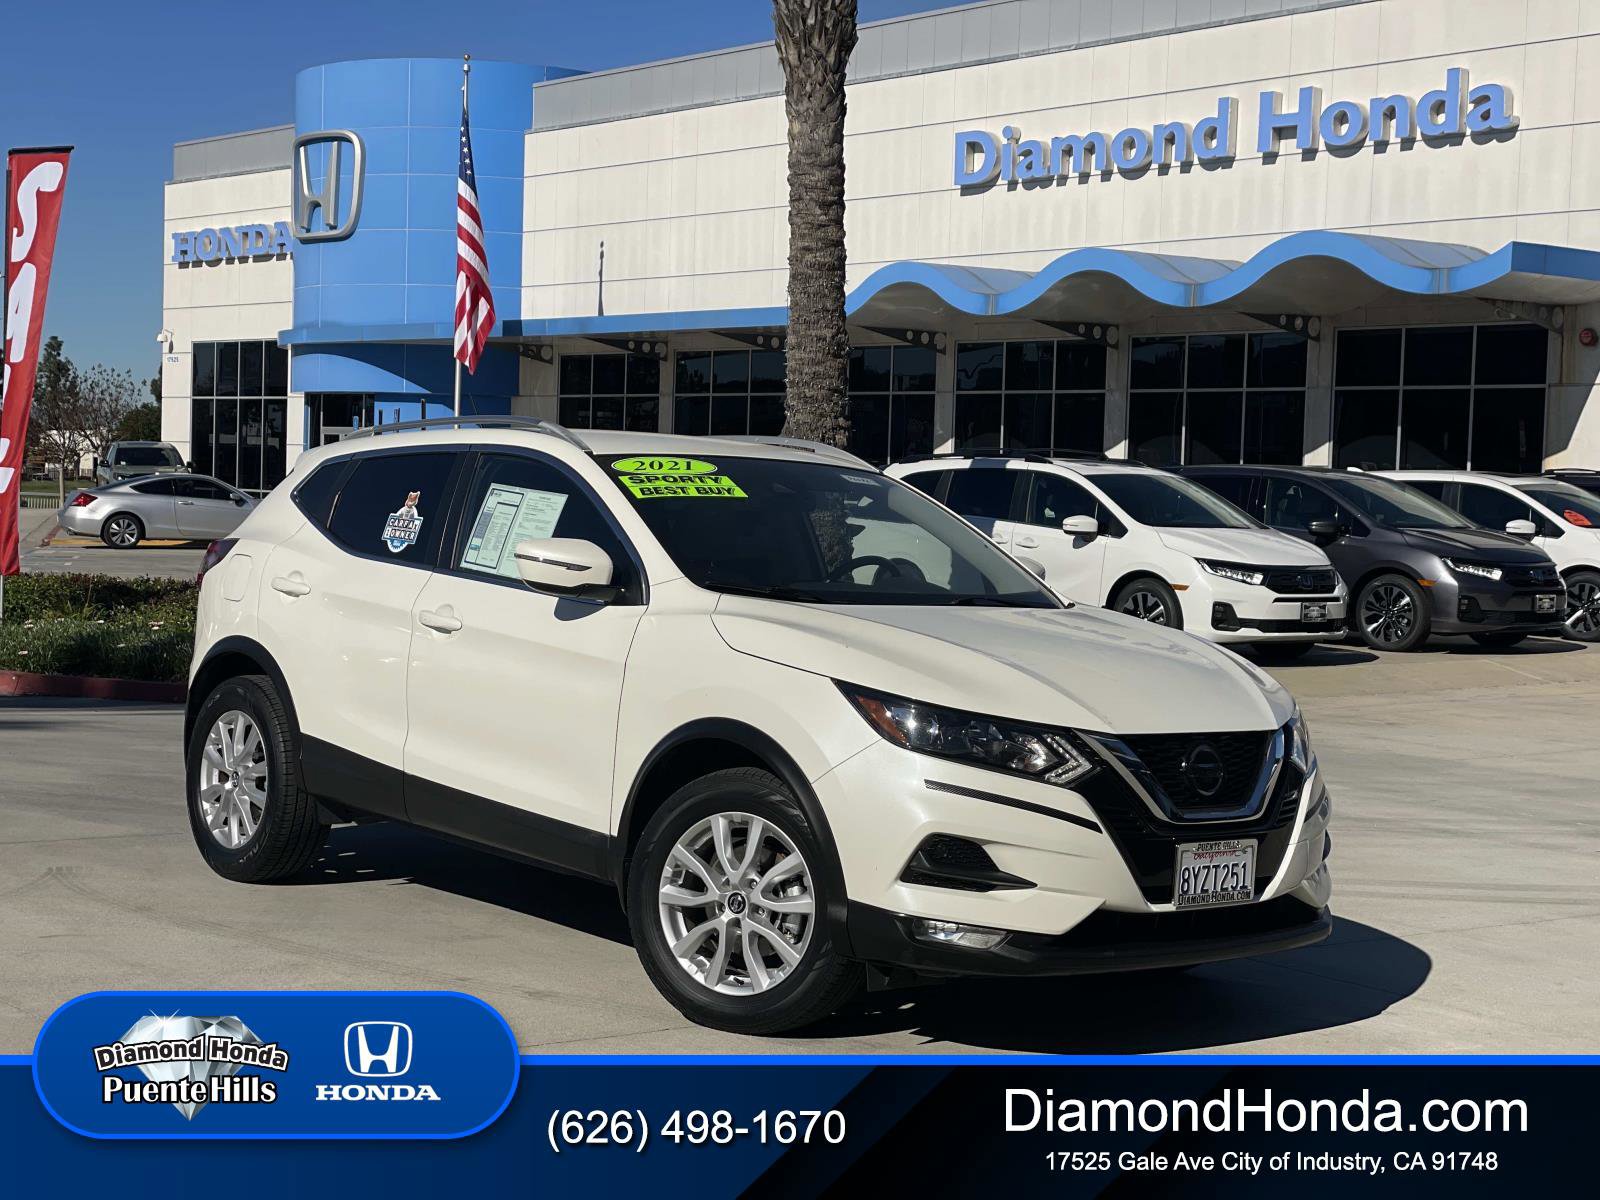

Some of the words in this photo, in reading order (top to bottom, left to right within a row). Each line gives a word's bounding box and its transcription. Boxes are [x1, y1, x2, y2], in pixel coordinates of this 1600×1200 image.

[954, 97, 1238, 187] Diamond
[1257, 67, 1519, 154] Honda
[171, 221, 293, 263] HONDA
[0, 160, 64, 494] SA
[628, 475, 723, 485] SPORTY
[634, 460, 693, 471] 2021
[639, 486, 690, 496] BEST
[694, 486, 735, 496] BUY
[1180, 862, 1248, 895] 8YZT251
